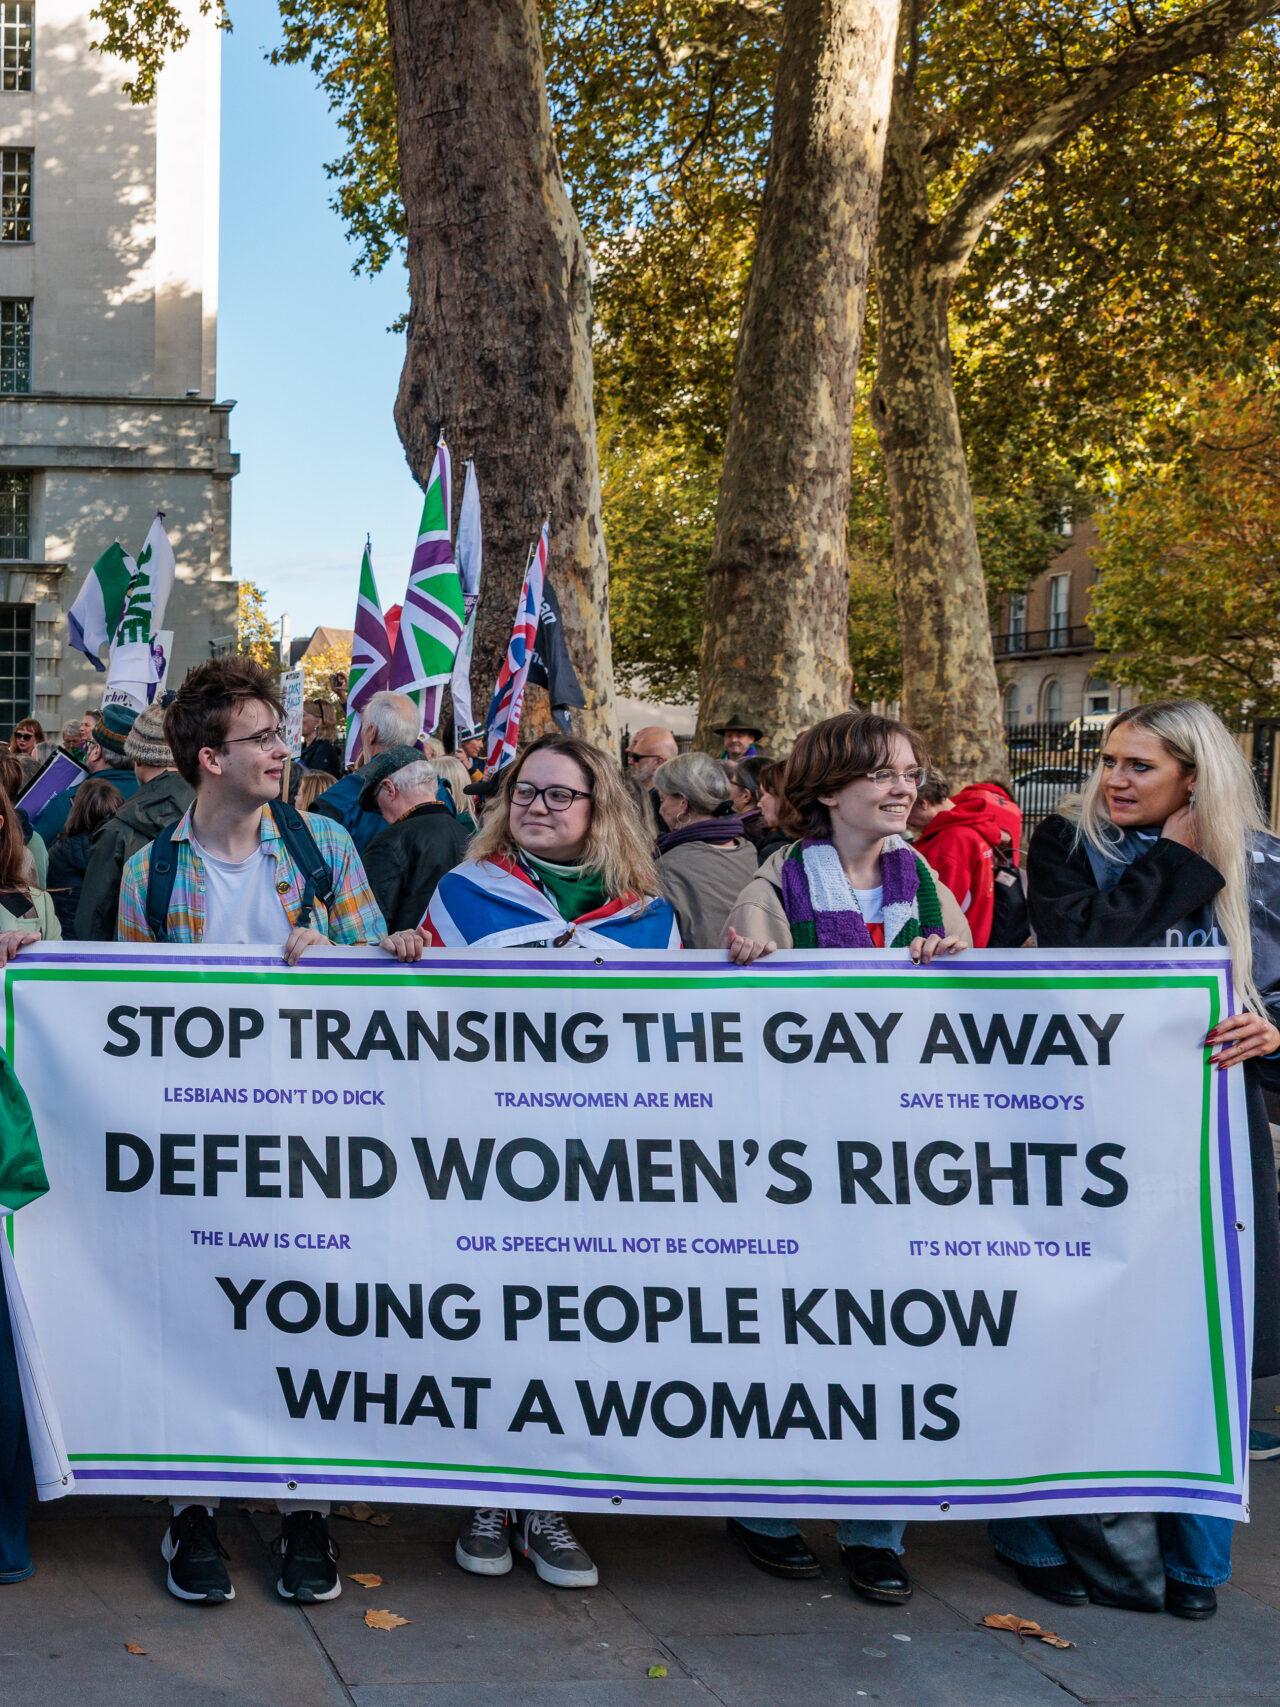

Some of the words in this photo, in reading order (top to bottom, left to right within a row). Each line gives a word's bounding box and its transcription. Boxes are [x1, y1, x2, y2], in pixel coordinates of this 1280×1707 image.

[103, 1005, 264, 1058] STOP
[279, 1009, 608, 1063] TRANSING
[623, 1012, 743, 1062] THE
[763, 1012, 903, 1063] GAY
[920, 1013, 1124, 1065] AWAY
[165, 1088, 248, 1103] LESBIANS
[254, 1089, 307, 1103] DON’T
[313, 1090, 338, 1104] DO
[344, 1091, 384, 1105] DICK
[495, 1093, 628, 1107] TRANSWOMEN
[634, 1093, 668, 1107] ARE
[675, 1093, 712, 1107] MEN
[901, 1093, 943, 1108] SAVE
[947, 1094, 979, 1108] THE
[984, 1094, 1084, 1110] TOMBOYS
[105, 1132, 397, 1199] DEFEND
[411, 1137, 812, 1204] WOMEN’S
[837, 1141, 1128, 1207] RIGHTS
[191, 1230, 223, 1246] THE
[229, 1232, 269, 1247] LAW
[275, 1234, 289, 1248] IS
[295, 1234, 351, 1249] CLEAR
[457, 1236, 497, 1251] OUR
[502, 1237, 570, 1252] SPEECH
[574, 1237, 617, 1252] WILL
[623, 1238, 660, 1253] NOT
[666, 1238, 687, 1253] BE
[692, 1239, 799, 1254] COMPELLED
[910, 1241, 940, 1256] IT’S
[945, 1241, 981, 1256] NOT
[987, 1241, 1030, 1256] KIND
[1035, 1242, 1059, 1256] TO
[1066, 1242, 1090, 1256] LIE
[215, 1277, 480, 1341] YOUNG
[503, 1285, 760, 1344] PEOPLE
[782, 1288, 1017, 1347] KNOW
[276, 1367, 491, 1429] WHAT
[507, 1379, 565, 1434] A
[575, 1380, 877, 1440] WOMAN
[901, 1384, 960, 1441] IS
